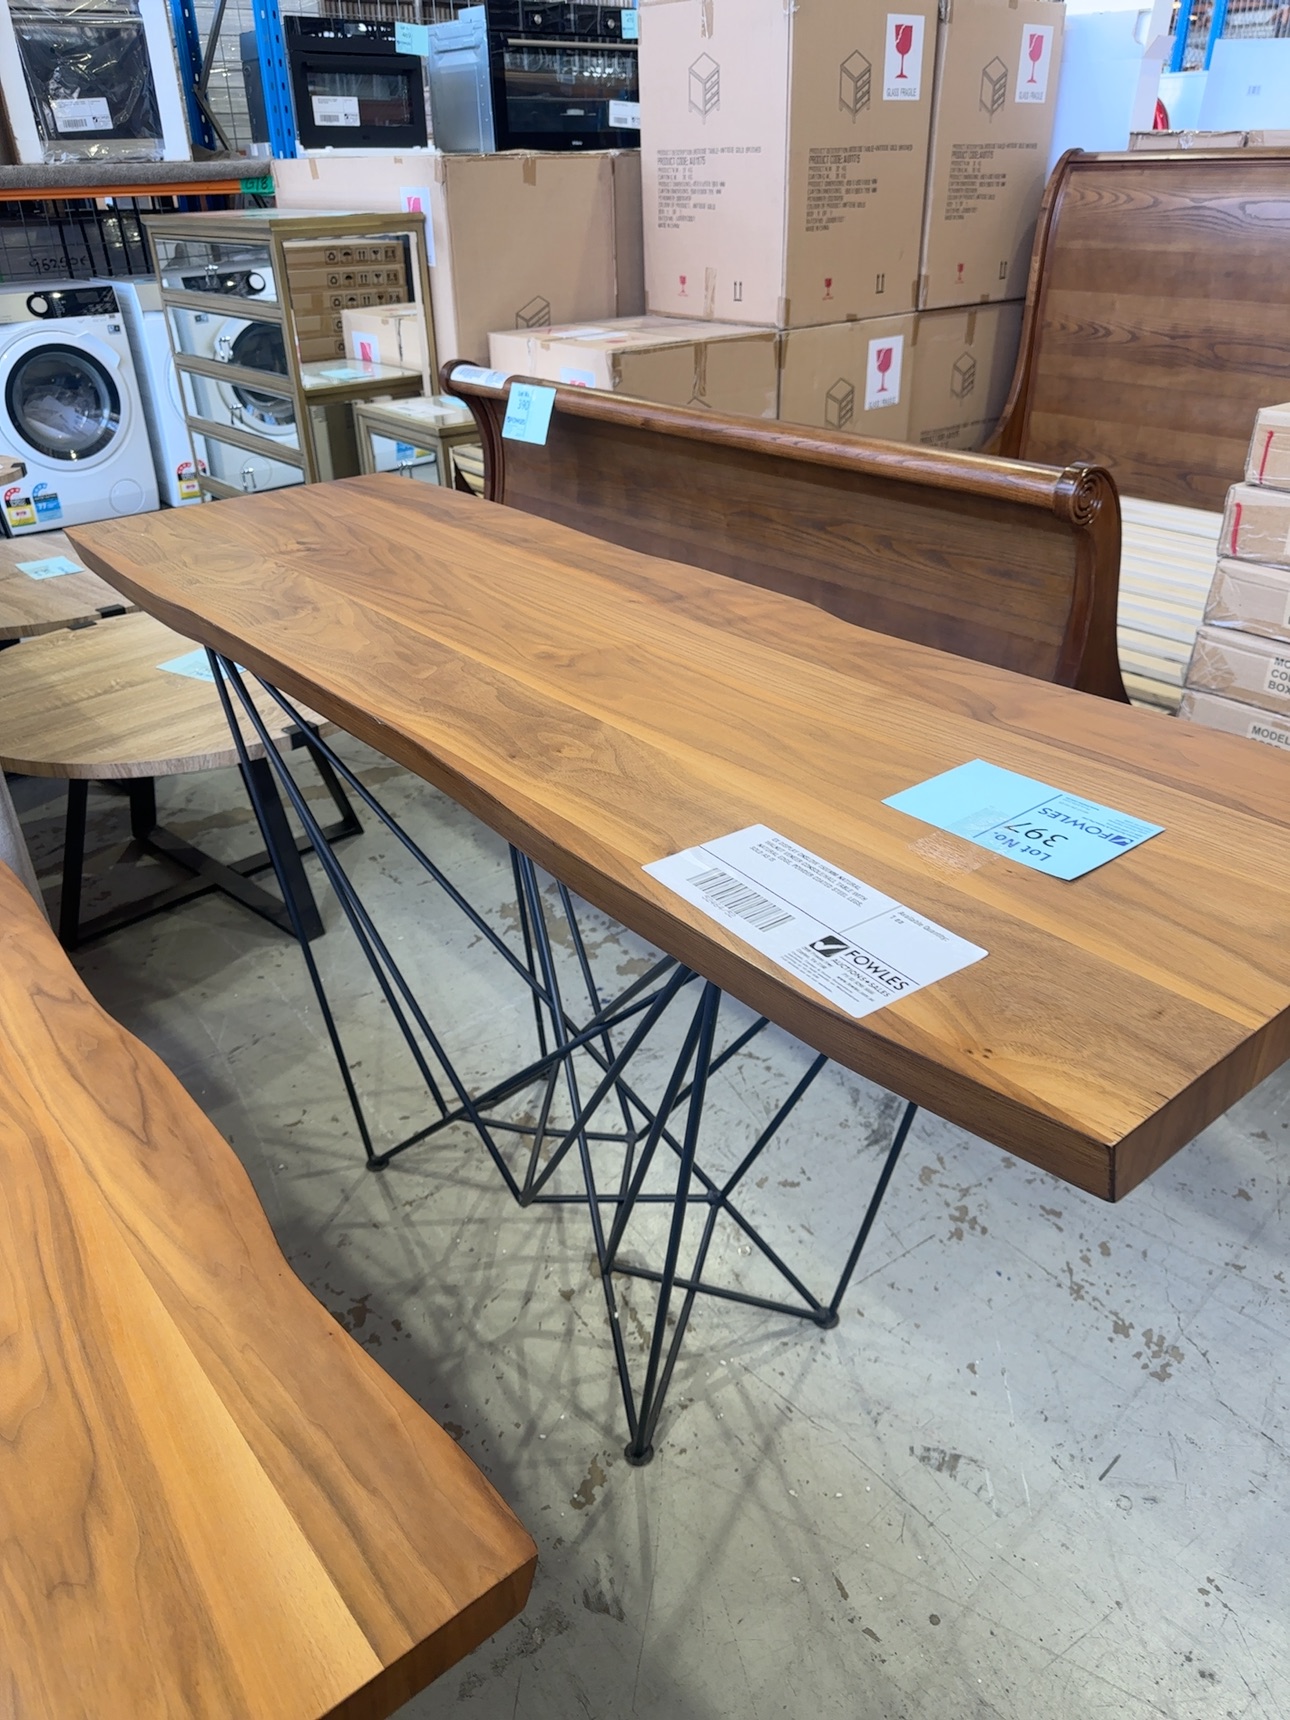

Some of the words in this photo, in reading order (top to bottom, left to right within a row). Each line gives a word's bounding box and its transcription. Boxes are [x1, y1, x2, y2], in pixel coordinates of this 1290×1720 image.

[1251, 726, 1290, 746] MODEL
[1038, 807, 1114, 840] FOWLES
[994, 832, 1021, 848] No.
[1004, 822, 1069, 848] 397
[1020, 845, 1052, 862] Lot
[898, 911, 924, 926] Available
[844, 950, 910, 991] FOWLES
